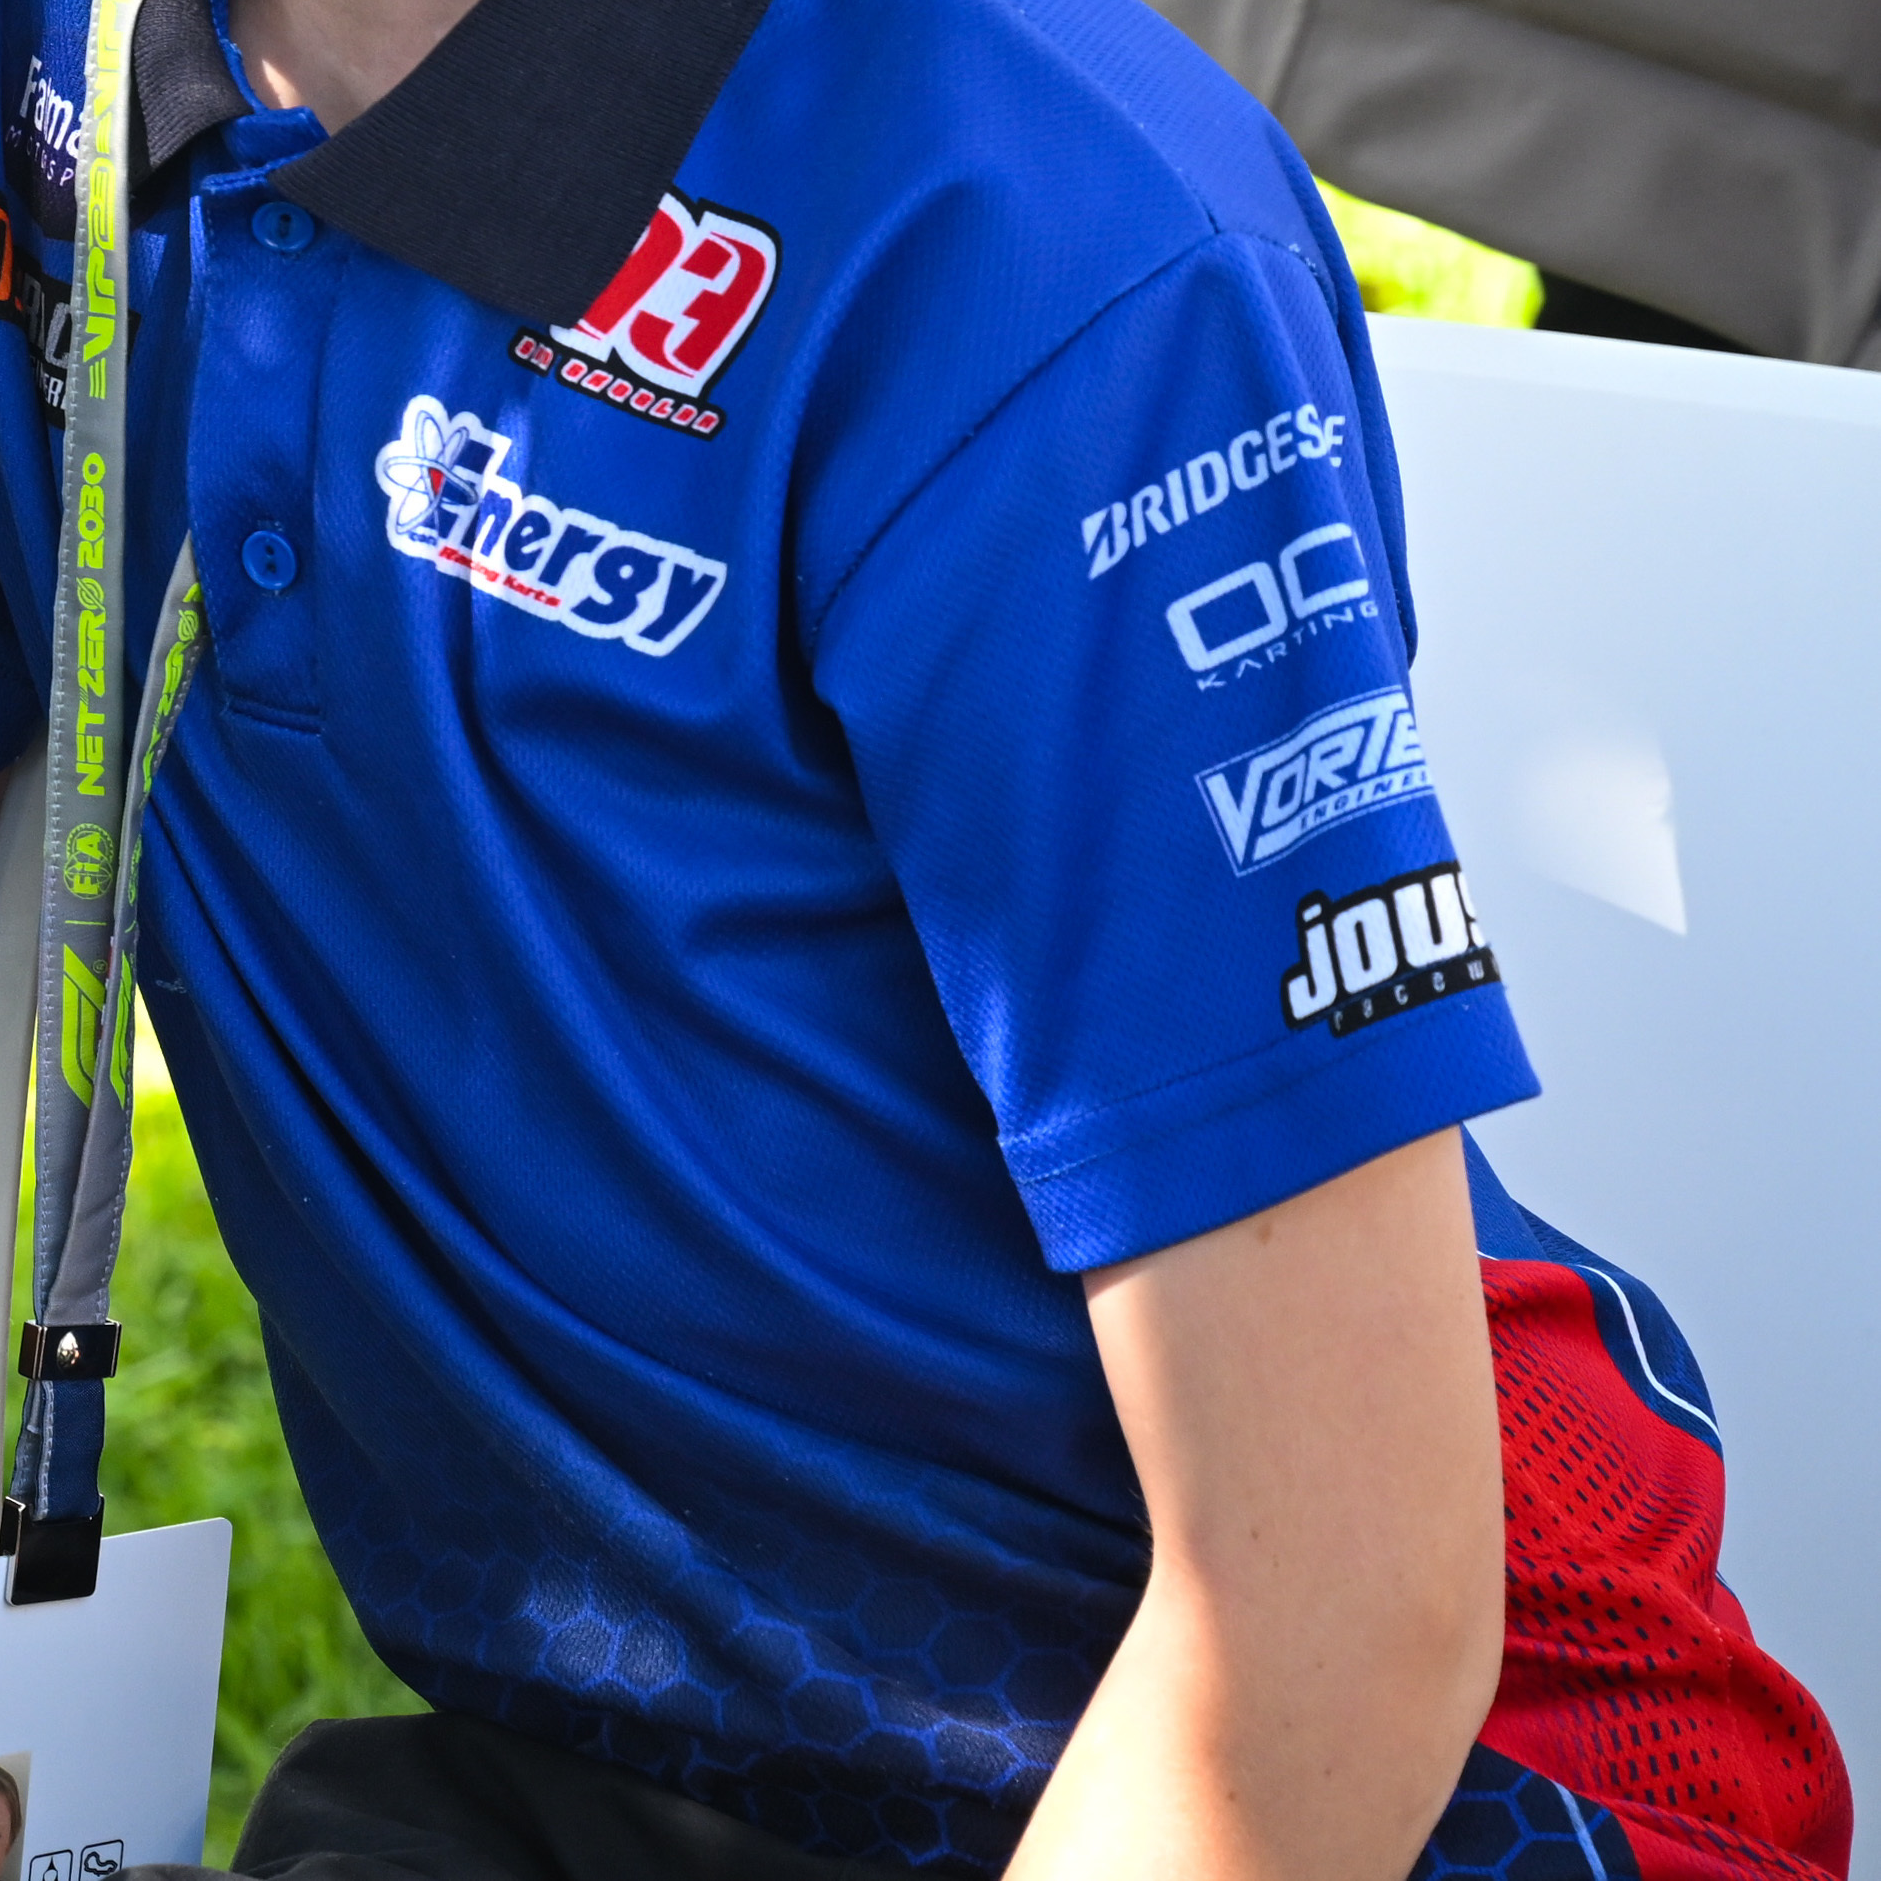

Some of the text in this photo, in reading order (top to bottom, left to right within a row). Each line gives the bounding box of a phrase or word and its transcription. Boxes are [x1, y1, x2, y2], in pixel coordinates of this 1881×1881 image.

[77, 452, 106, 569] 2030
[420, 439, 718, 643] Energy
[1195, 600, 1379, 692] KARTING
